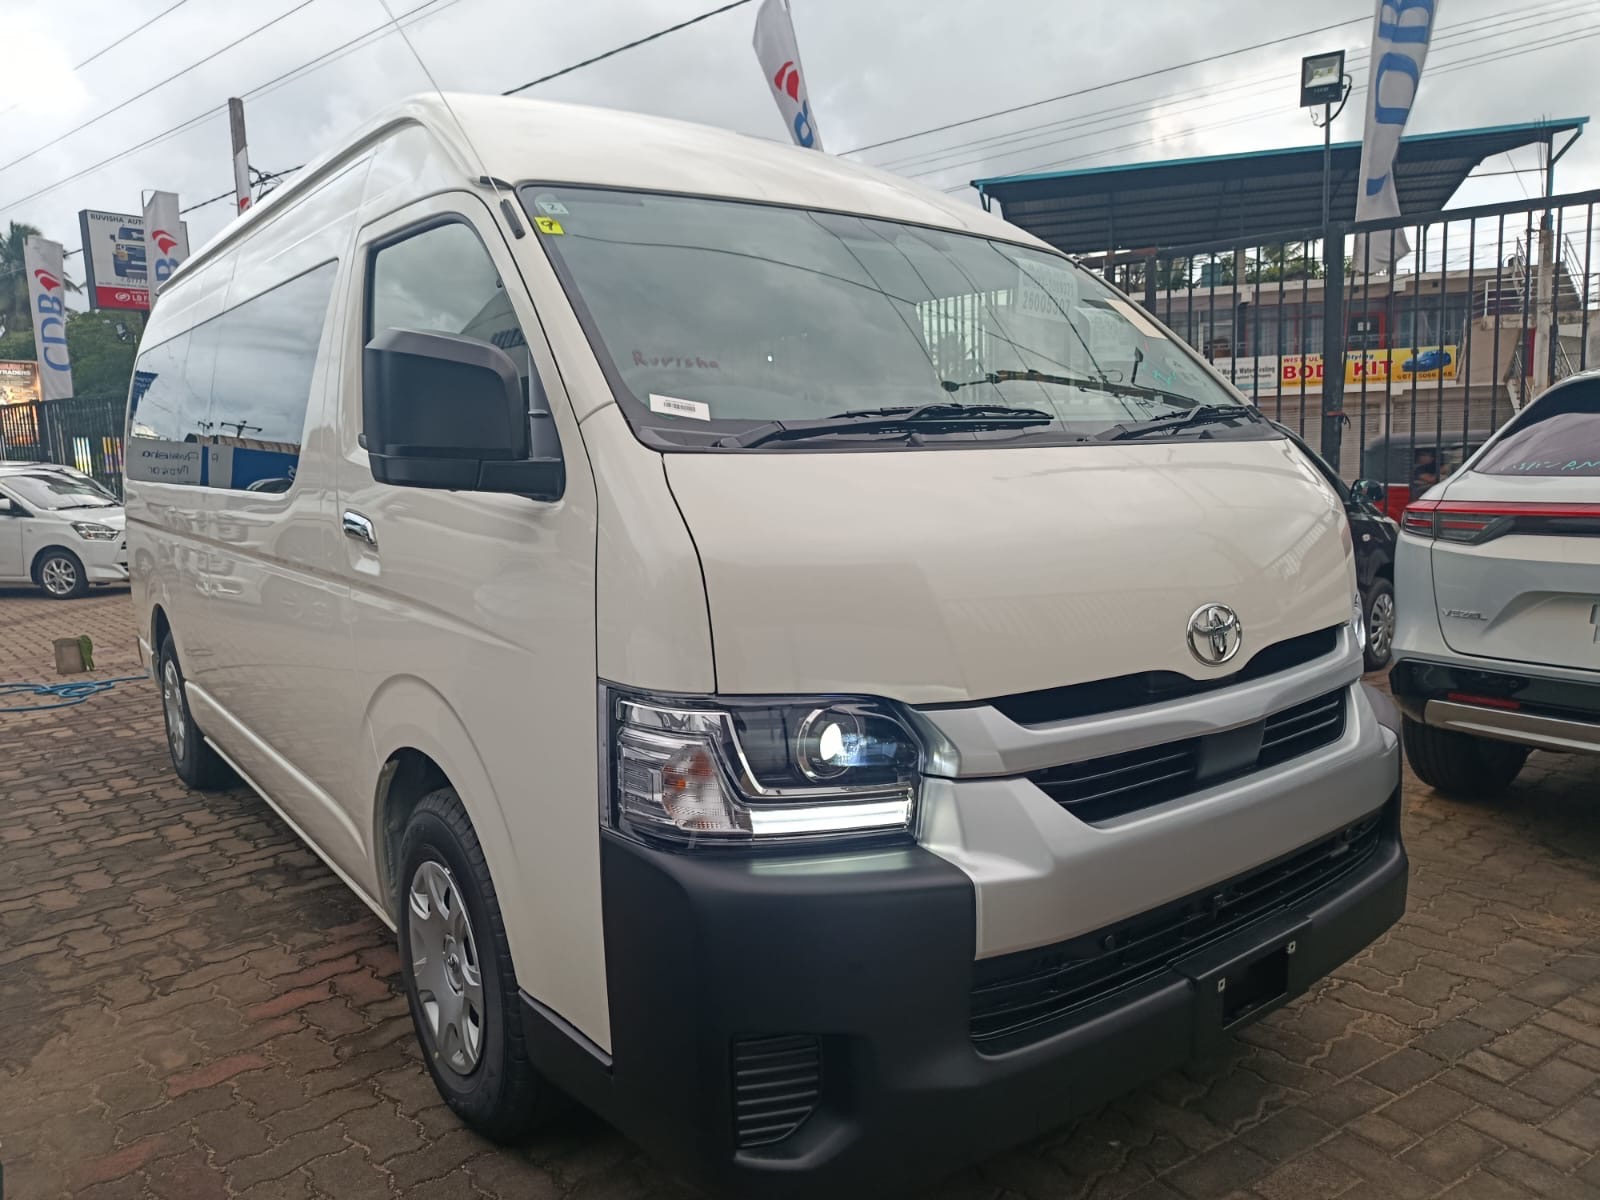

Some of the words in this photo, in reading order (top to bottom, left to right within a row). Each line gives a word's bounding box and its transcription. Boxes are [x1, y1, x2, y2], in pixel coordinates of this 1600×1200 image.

[90, 213, 125, 223] RUVISHA
[37, 293, 71, 371] CDB
[1283, 364, 1324, 379] BOD
[1354, 360, 1394, 376] KIT
[1441, 607, 1488, 621] VEZEL
